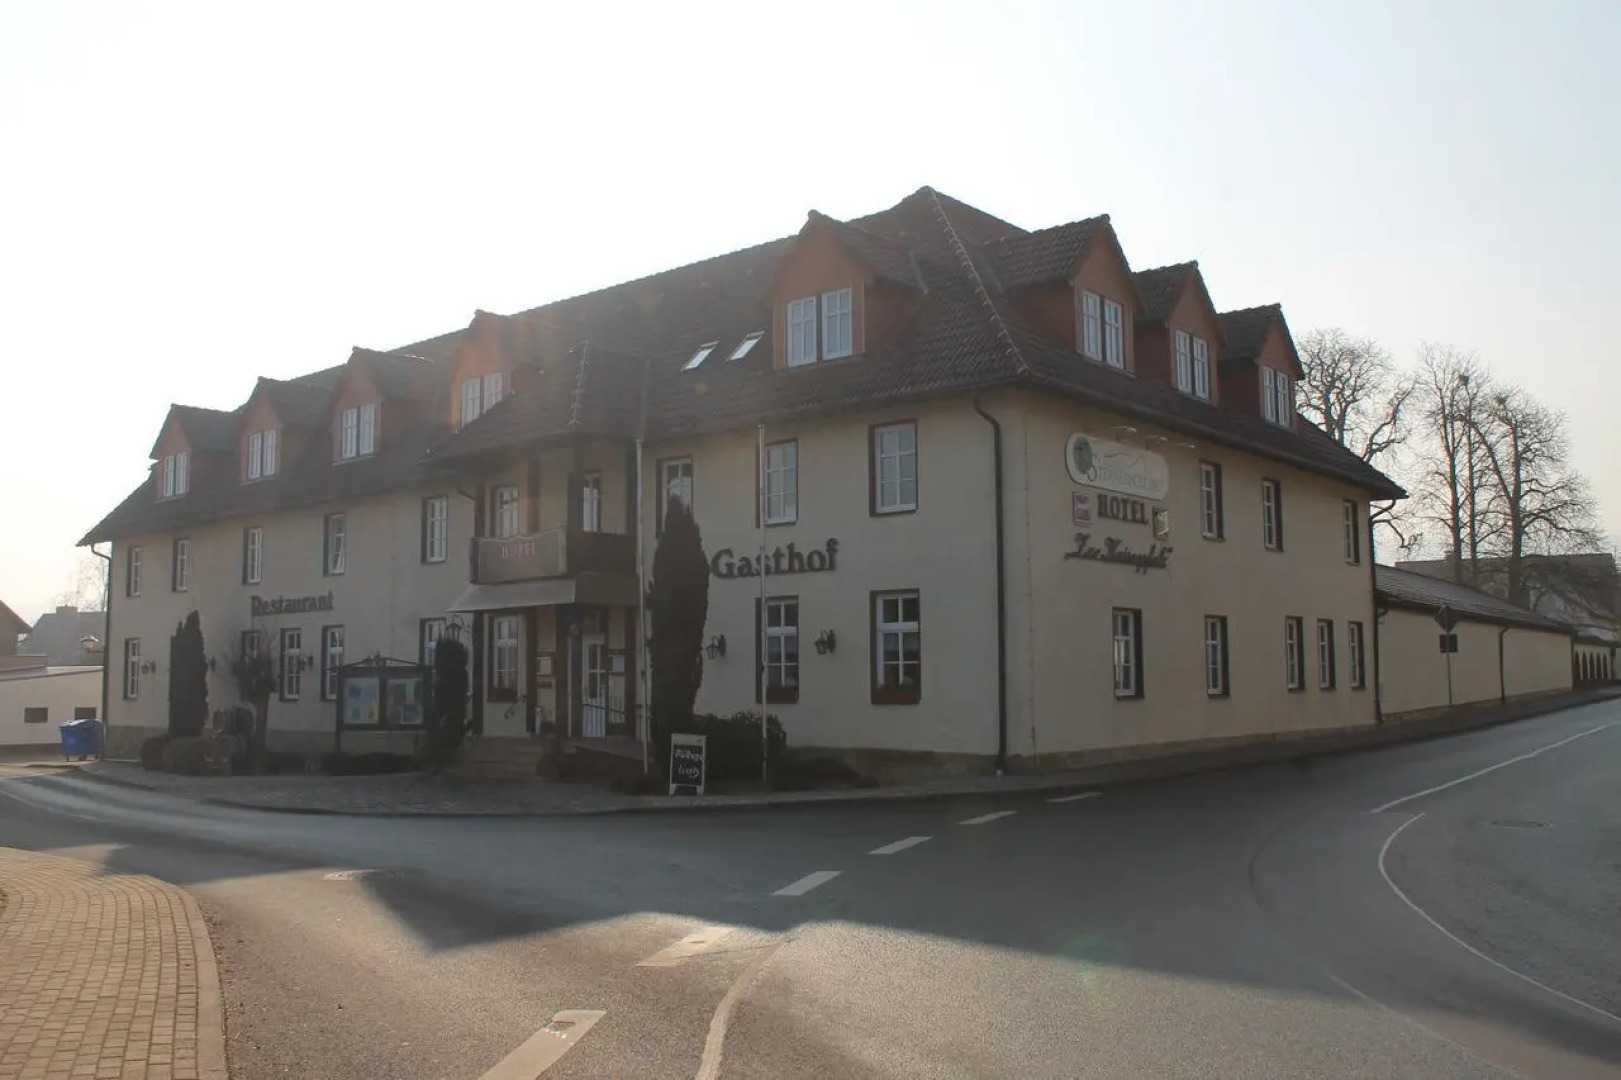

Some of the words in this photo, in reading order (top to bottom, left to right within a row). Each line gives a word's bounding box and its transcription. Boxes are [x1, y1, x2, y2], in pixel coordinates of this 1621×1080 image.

[1097, 493, 1149, 525] HOTEL
[502, 541, 538, 559] HOTEL
[711, 537, 839, 579] Gasthof
[250, 589, 335, 617] Restaurant
